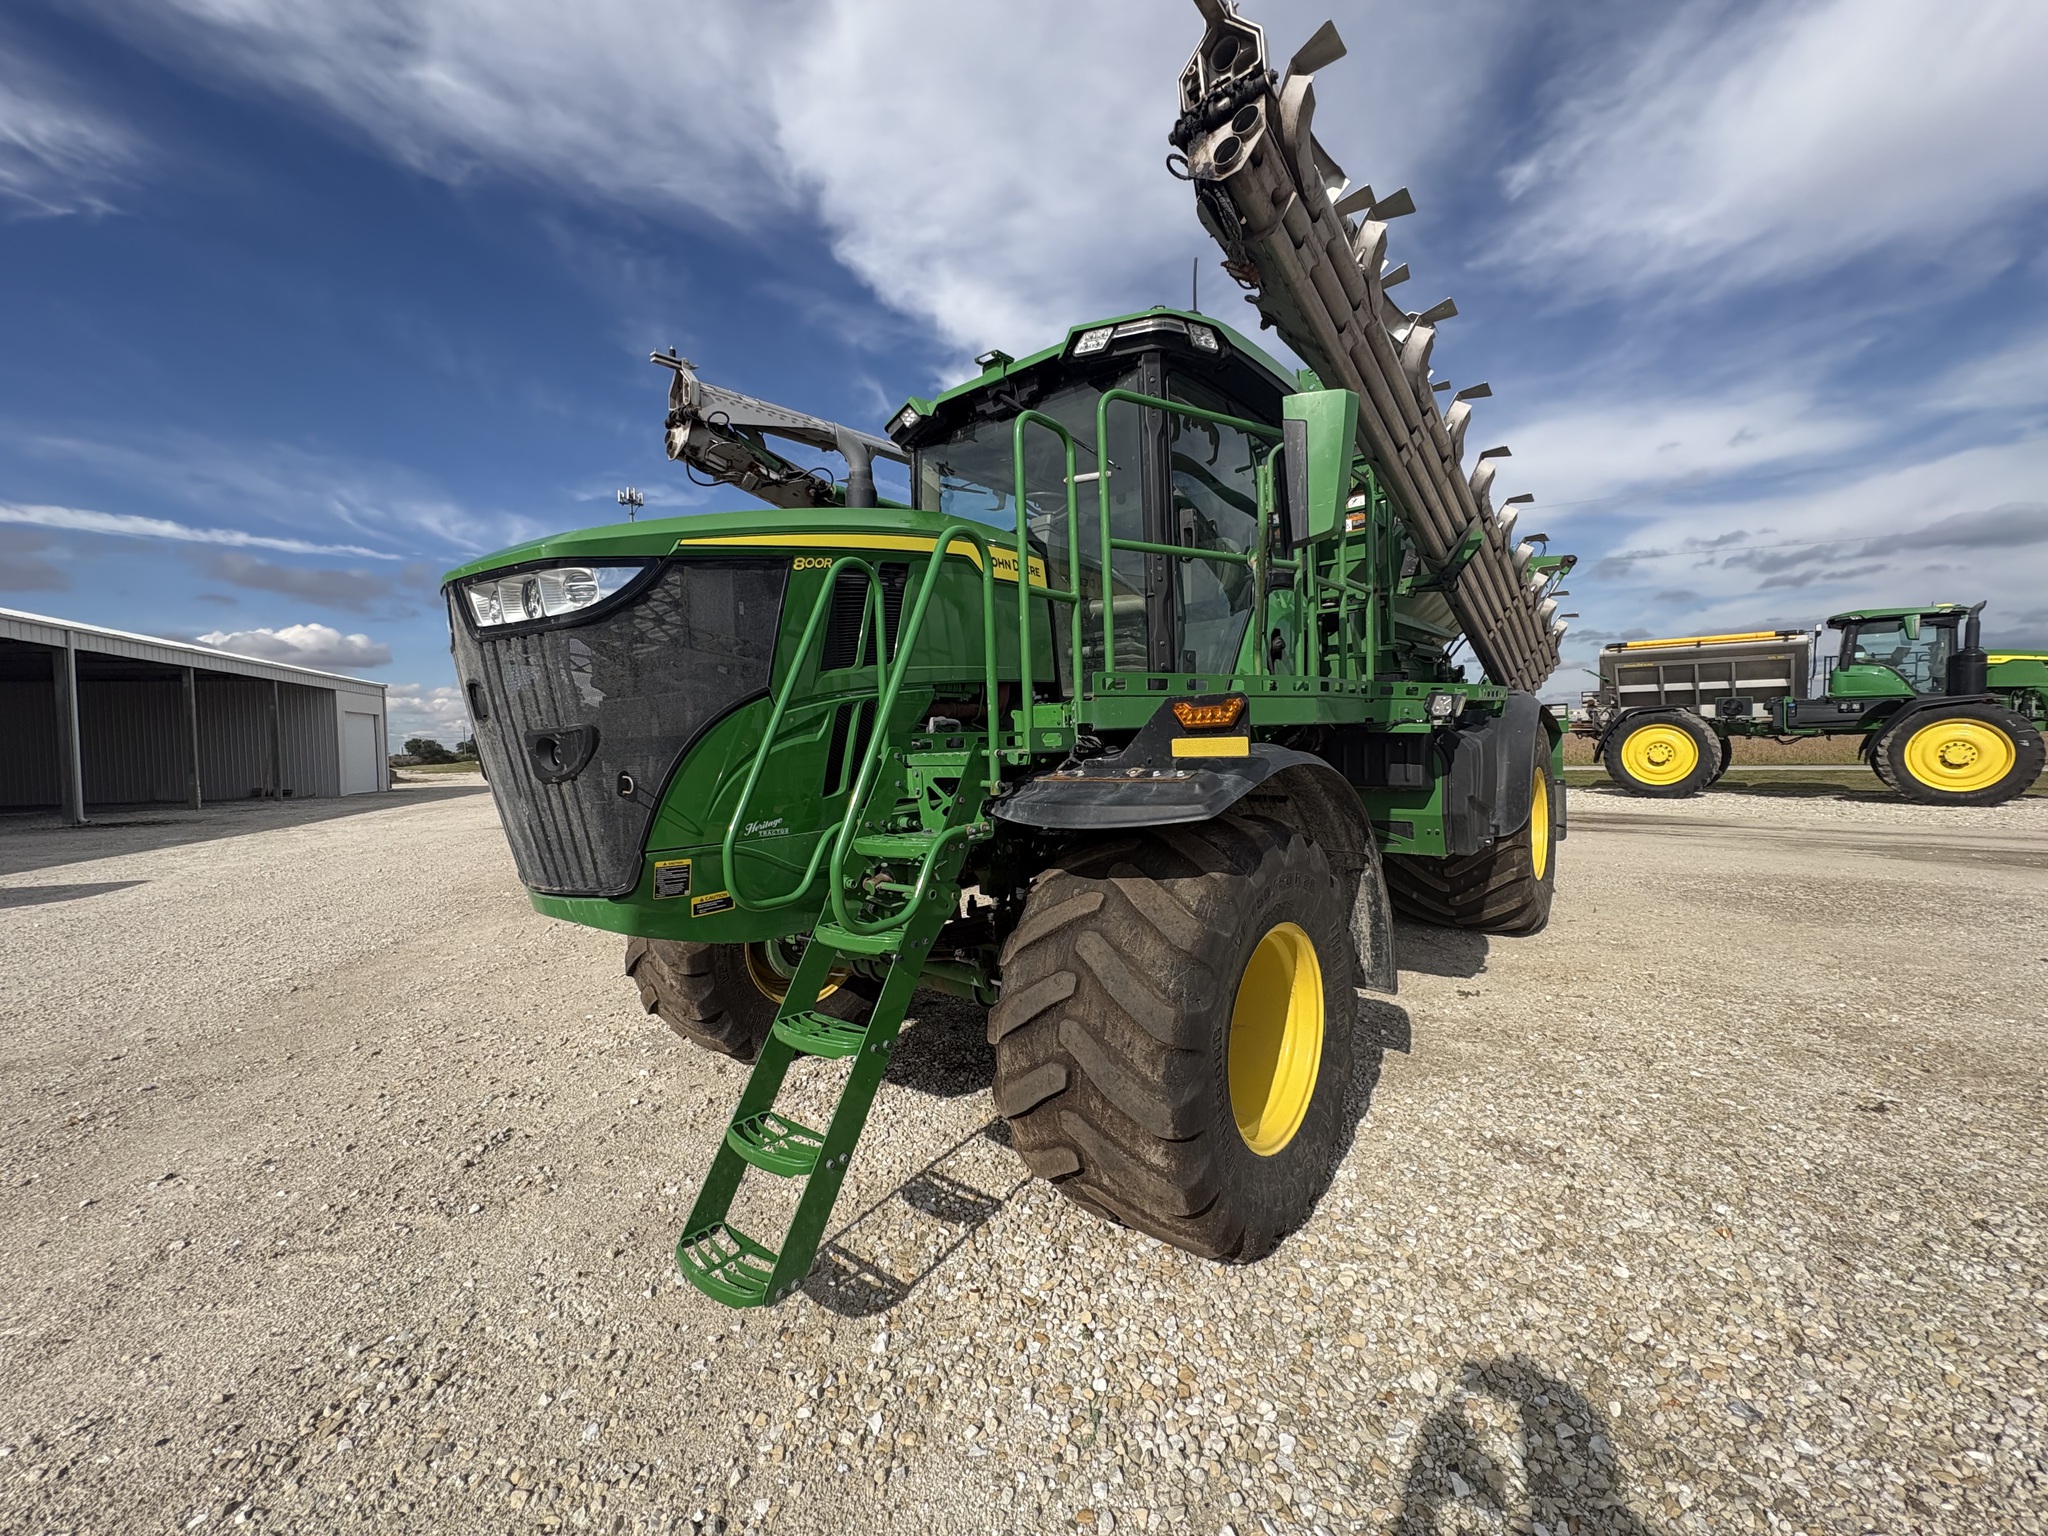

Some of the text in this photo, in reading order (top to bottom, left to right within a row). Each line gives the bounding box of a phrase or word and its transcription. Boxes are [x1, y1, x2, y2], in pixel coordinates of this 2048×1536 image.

[793, 557, 833, 570] 800R
[992, 557, 1041, 577] OHN DRE
[744, 818, 783, 836] Heritage
[705, 893, 728, 901] CAUTION
